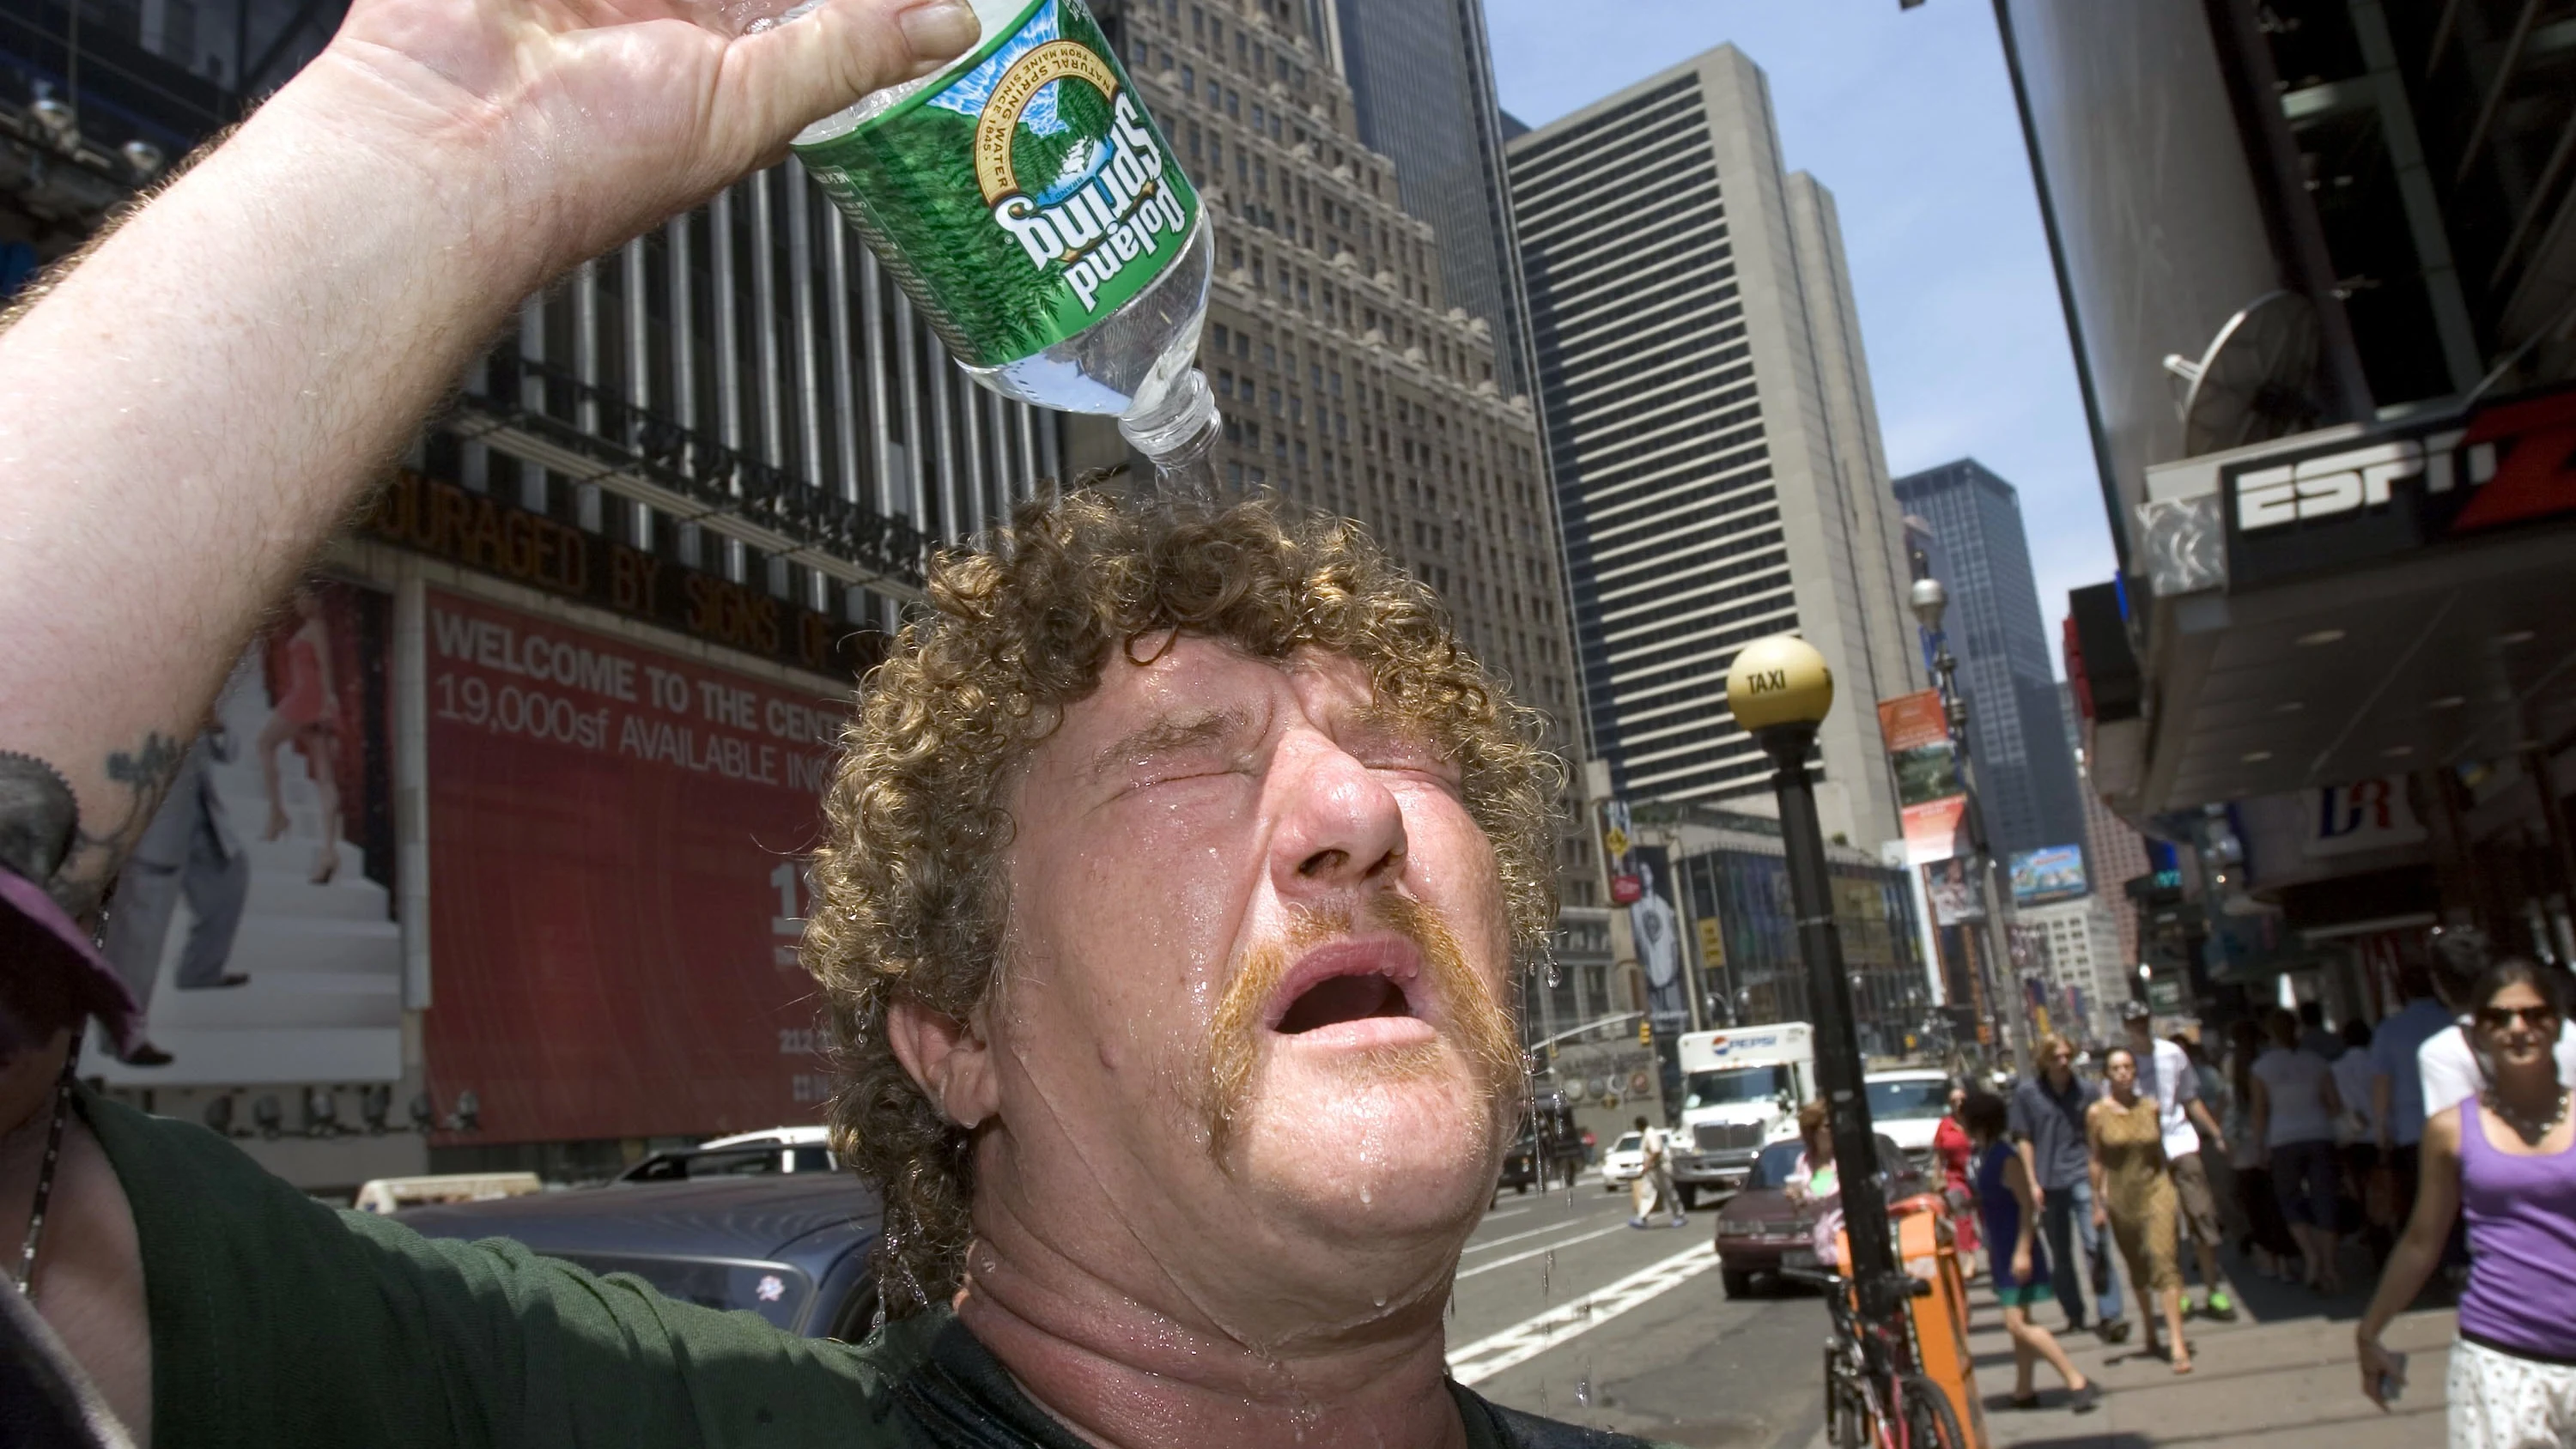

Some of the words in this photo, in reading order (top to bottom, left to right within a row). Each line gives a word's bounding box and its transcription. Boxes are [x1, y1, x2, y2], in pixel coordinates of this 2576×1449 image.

[1024, 50, 1057, 74] MAINE
[1052, 58, 1110, 91] NATURAL
[1060, 48, 1088, 62] FROM
[993, 73, 1022, 113] SINCE
[1001, 65, 1048, 121] SPRING
[983, 118, 996, 152] 1845
[993, 127, 1008, 188] WATER
[994, 92, 1163, 272] Spring
[1054, 176, 1084, 200] BRAND
[1063, 177, 1186, 314] Poland
[2235, 428, 2496, 531] ESPN
[374, 470, 587, 595] OURAGED
[612, 543, 660, 616] BY
[684, 572, 781, 651] SIGNS
[799, 611, 836, 667] OF
[431, 609, 637, 703] WELCOME
[645, 665, 688, 713] TO
[700, 681, 759, 733] THE
[765, 698, 847, 745] CENT
[1747, 668, 1787, 694] TAXI
[436, 672, 611, 750] 19,000sf
[619, 713, 778, 785] AVAILABLE
[1729, 1035, 1777, 1049] PEPSI
